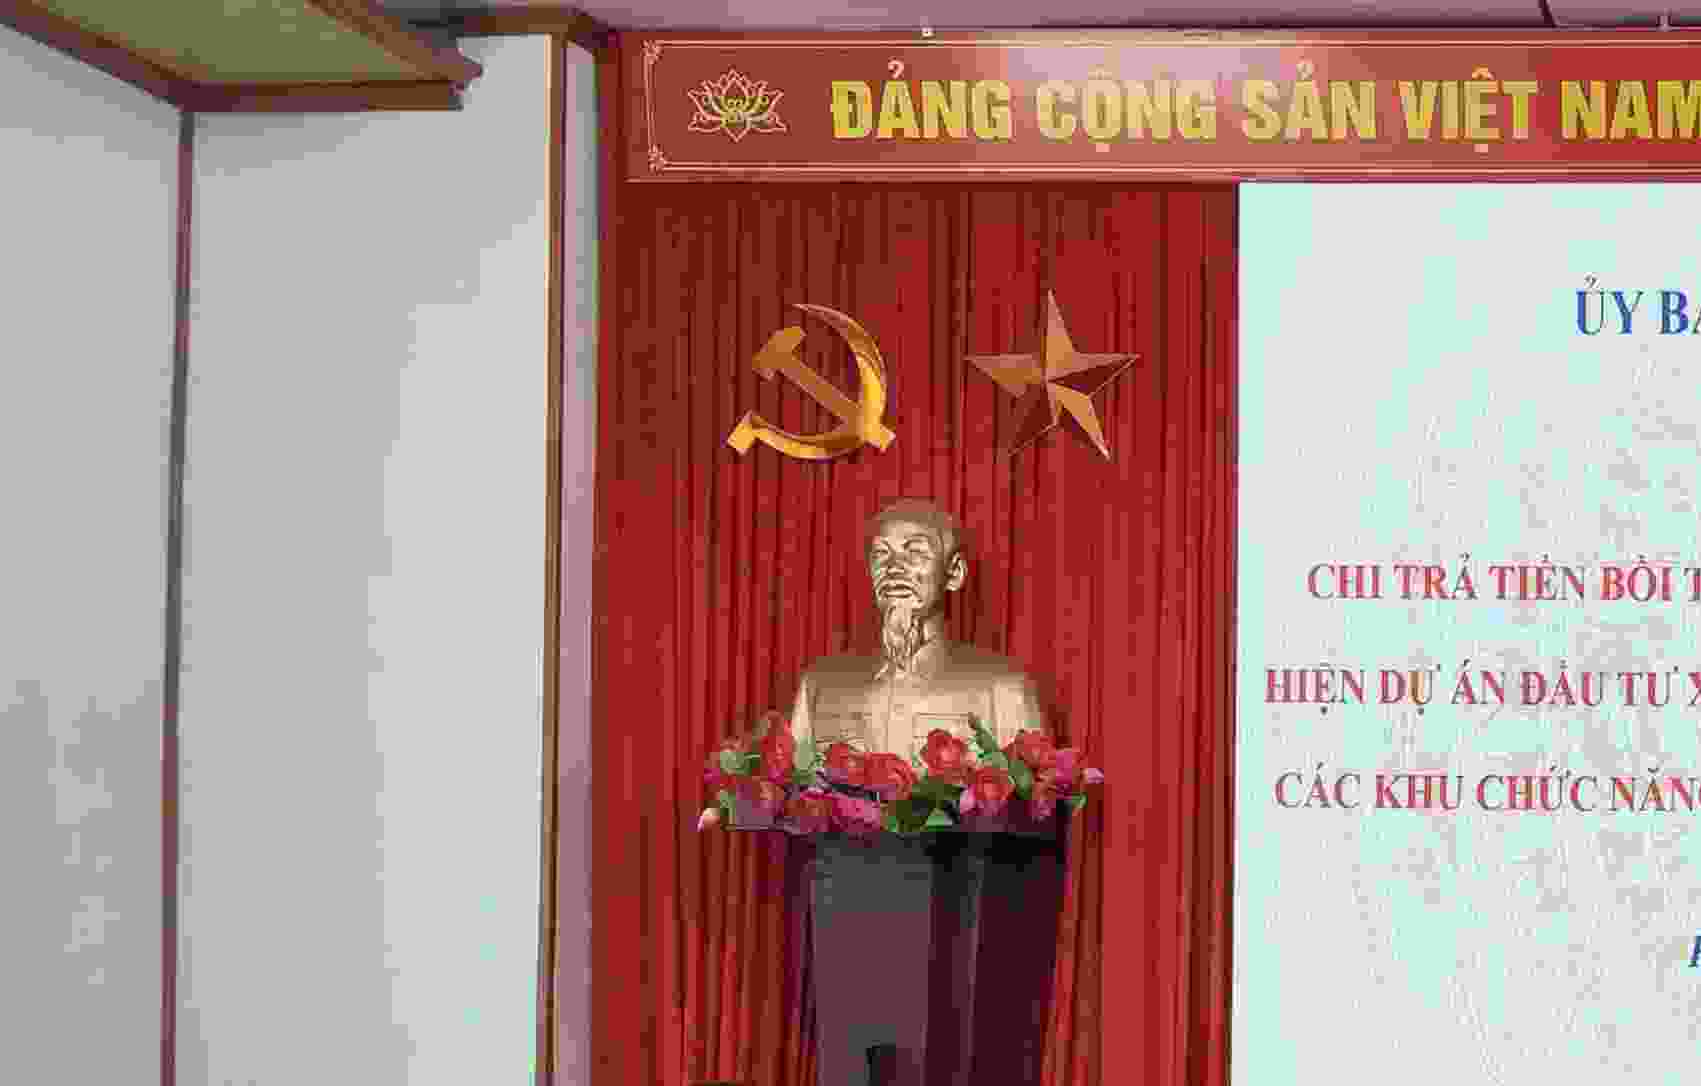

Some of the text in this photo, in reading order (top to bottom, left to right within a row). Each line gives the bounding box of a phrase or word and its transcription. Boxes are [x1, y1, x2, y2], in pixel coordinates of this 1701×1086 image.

[830, 58, 1009, 142] ĐẢNG
[1036, 68, 1215, 154] CỘNG
[1242, 60, 1379, 142] SẢN
[1399, 67, 1540, 154] VIỆT
[1576, 276, 1644, 335] ỦY
[1307, 563, 1382, 599] CHI
[1394, 554, 1478, 600] TRẢ
[1488, 554, 1585, 601] TIỀN
[1599, 554, 1673, 602] BỒI
[1265, 665, 1366, 715] HIỆN
[1379, 664, 1441, 715] DỰ
[1452, 659, 1506, 705] ÁN
[1519, 659, 1606, 706] ĐẦU
[1617, 666, 1679, 706] TƯ
[1274, 762, 1361, 809] CÁC
[1375, 773, 1464, 811] KHU
[1476, 765, 1599, 812] CHỨC
